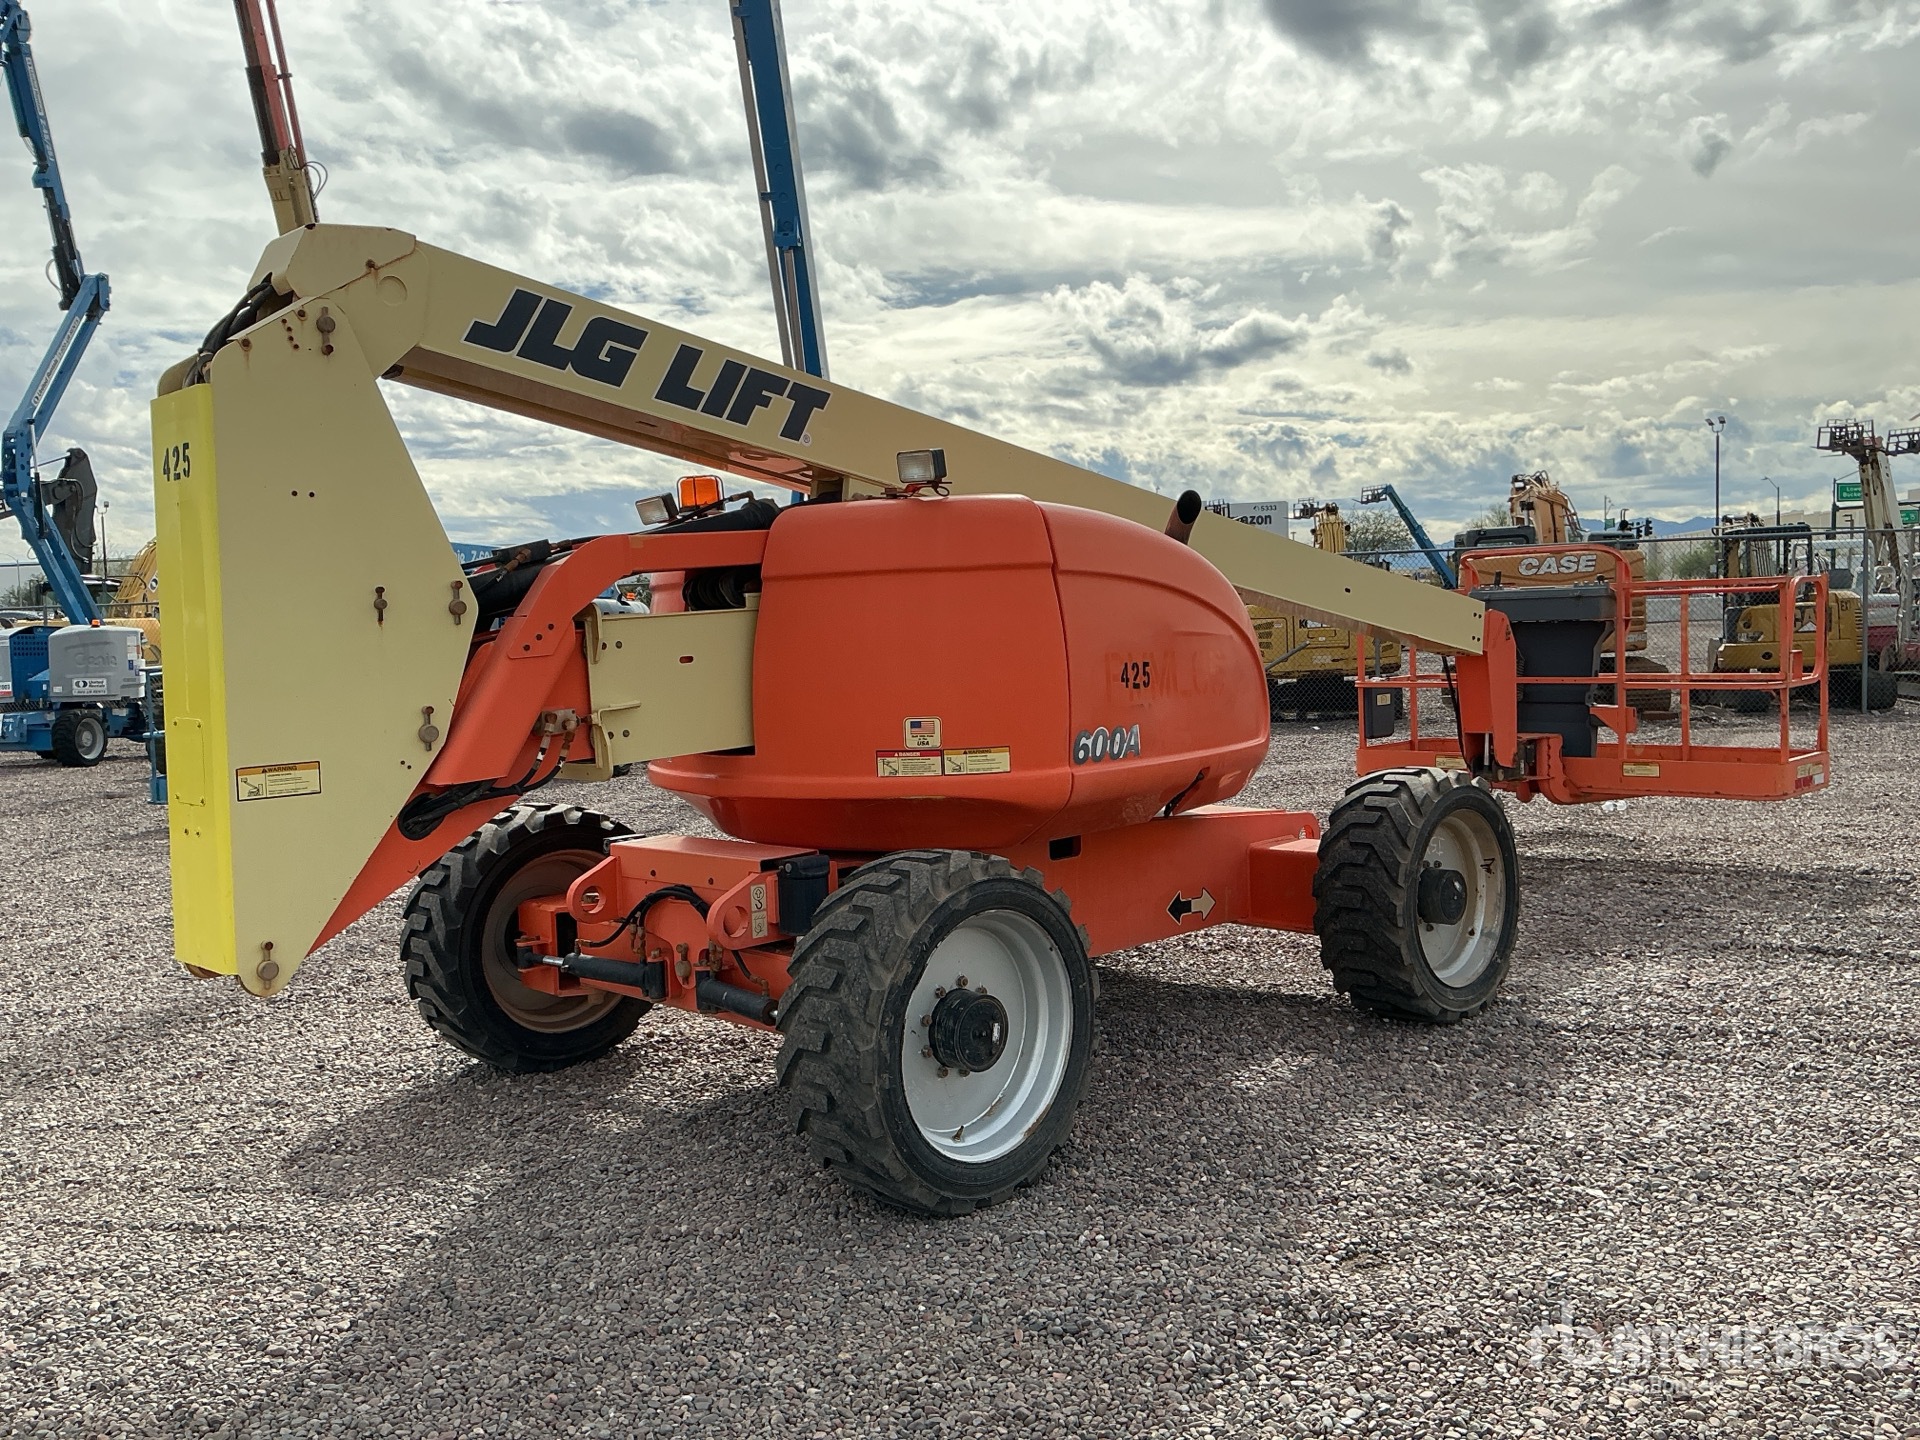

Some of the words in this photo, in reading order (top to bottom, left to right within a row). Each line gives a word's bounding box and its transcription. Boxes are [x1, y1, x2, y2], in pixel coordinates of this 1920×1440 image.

[464, 288, 649, 388] JLG
[654, 343, 831, 442] LIFT
[162, 442, 191, 482] 425
[1518, 554, 1597, 576] CASE
[1120, 661, 1150, 690] 425
[1072, 724, 1141, 765] 600A
[266, 765, 298, 773] WARNING
